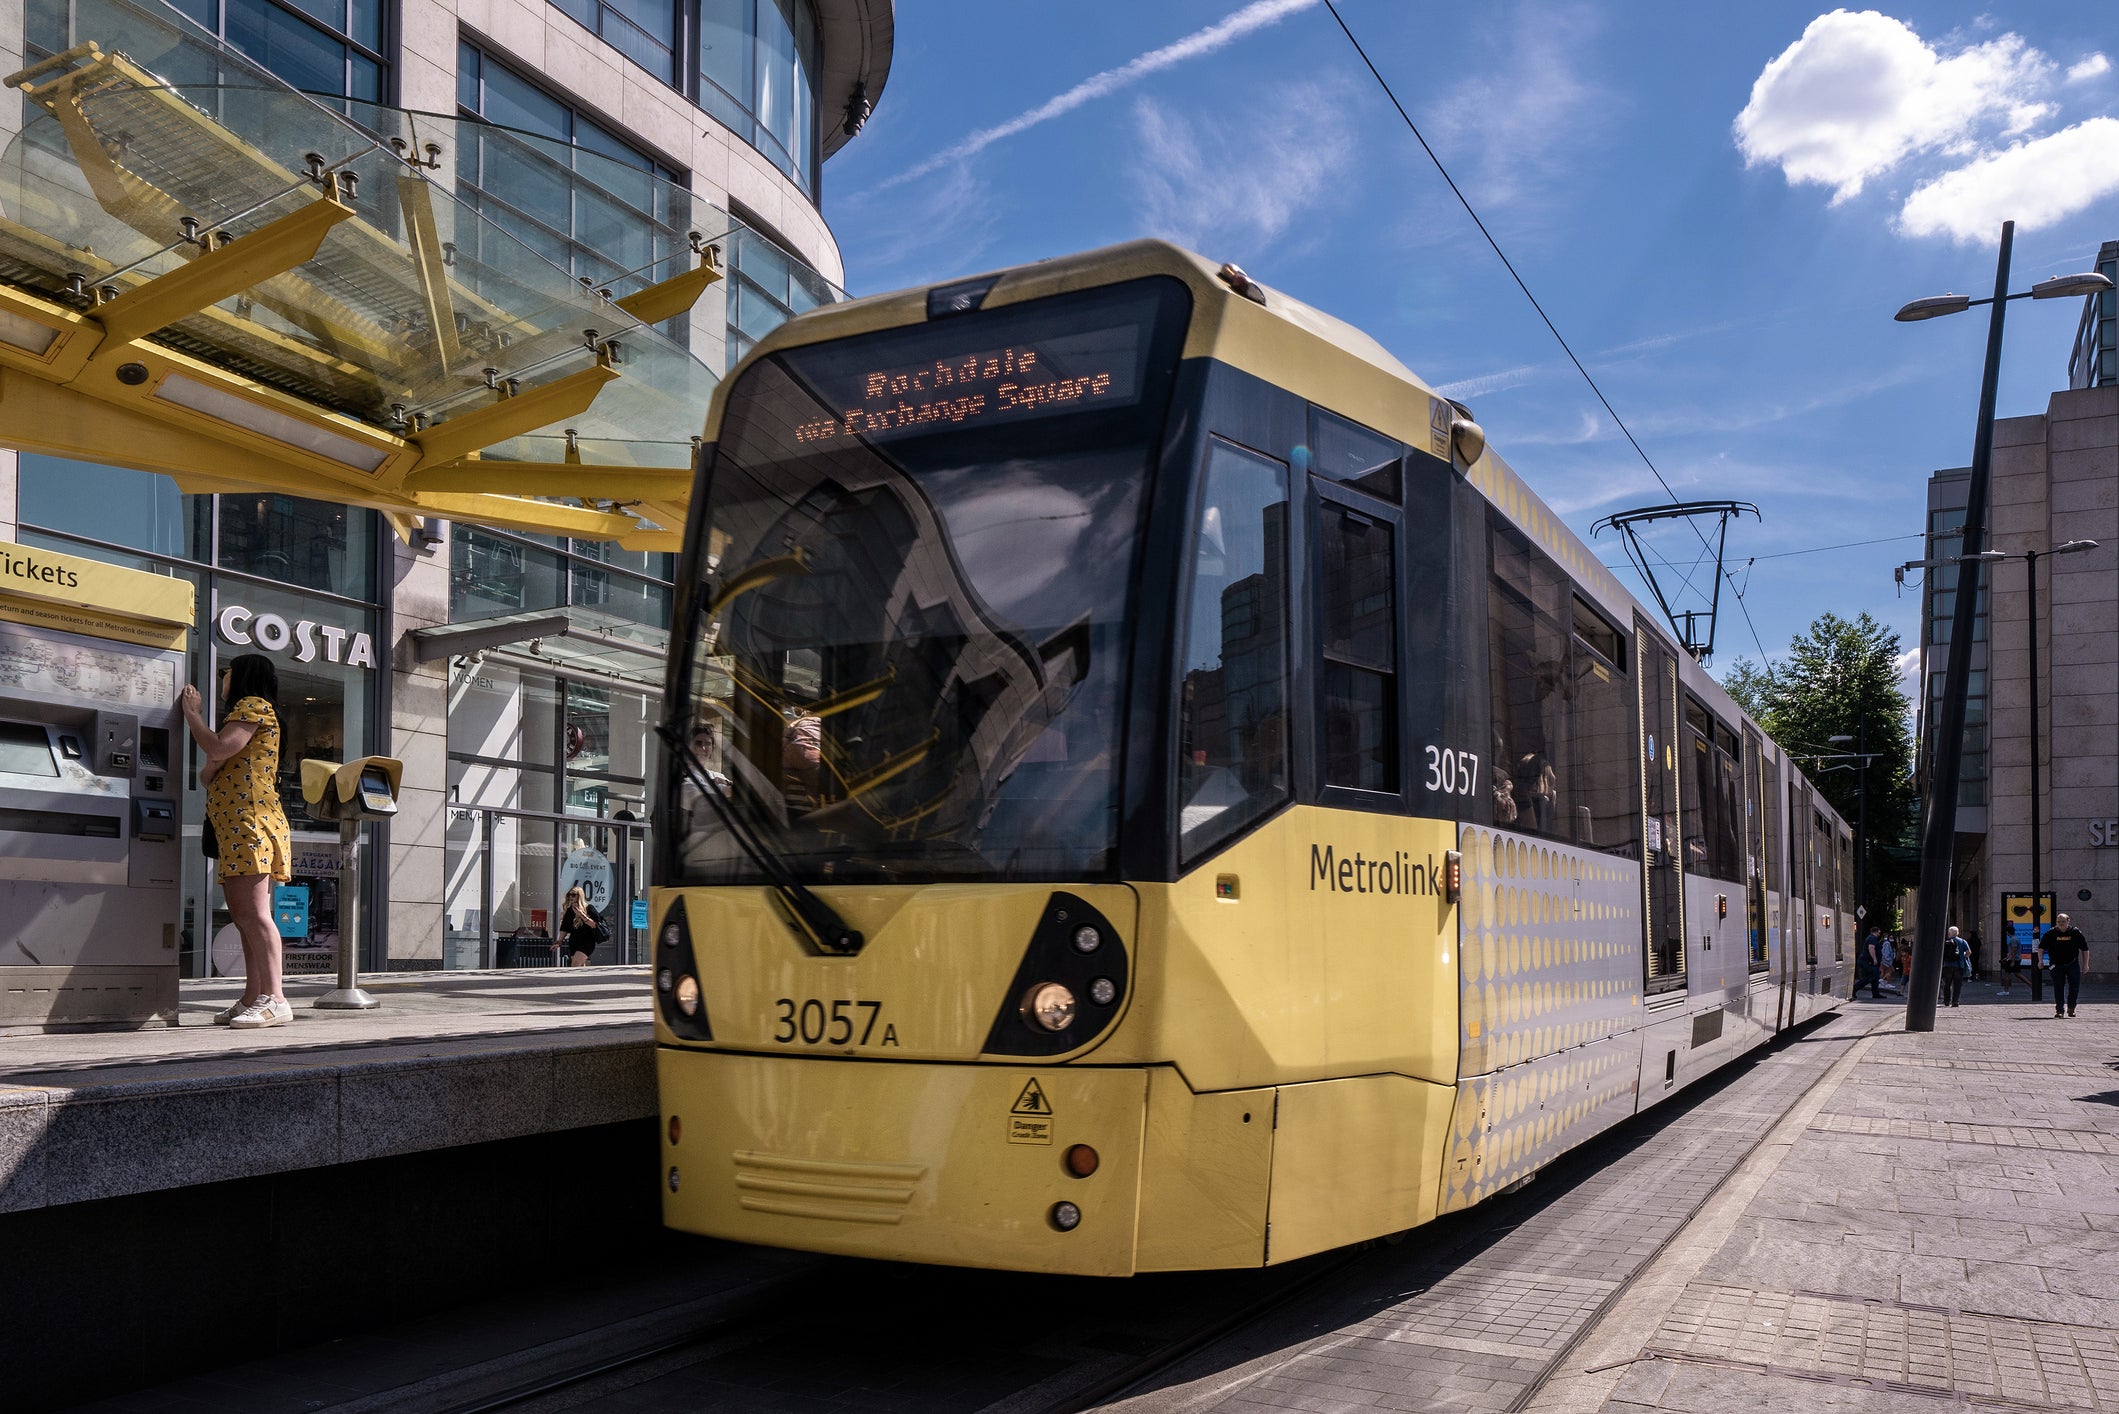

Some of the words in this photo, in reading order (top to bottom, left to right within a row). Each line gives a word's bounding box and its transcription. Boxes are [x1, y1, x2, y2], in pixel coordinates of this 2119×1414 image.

[998, 373, 1110, 410] Square
[20, 606, 34, 616] and
[35, 610, 60, 620] season
[60, 613, 84, 625] tickets
[84, 618, 95, 626] for
[95, 620, 104, 628] all
[104, 623, 136, 634] Metrolink
[136, 628, 175, 641] destinations
[217, 605, 375, 669] COSTA
[453, 671, 493, 689] WOMEN
[1425, 745, 1479, 797] 3057
[450, 809, 506, 825] MEN/HME
[2089, 818, 2119, 847] SE
[1310, 843, 1441, 897] Metrolink
[307, 953, 333, 961] FLOOR
[1014, 1120, 1049, 1133] Danger
